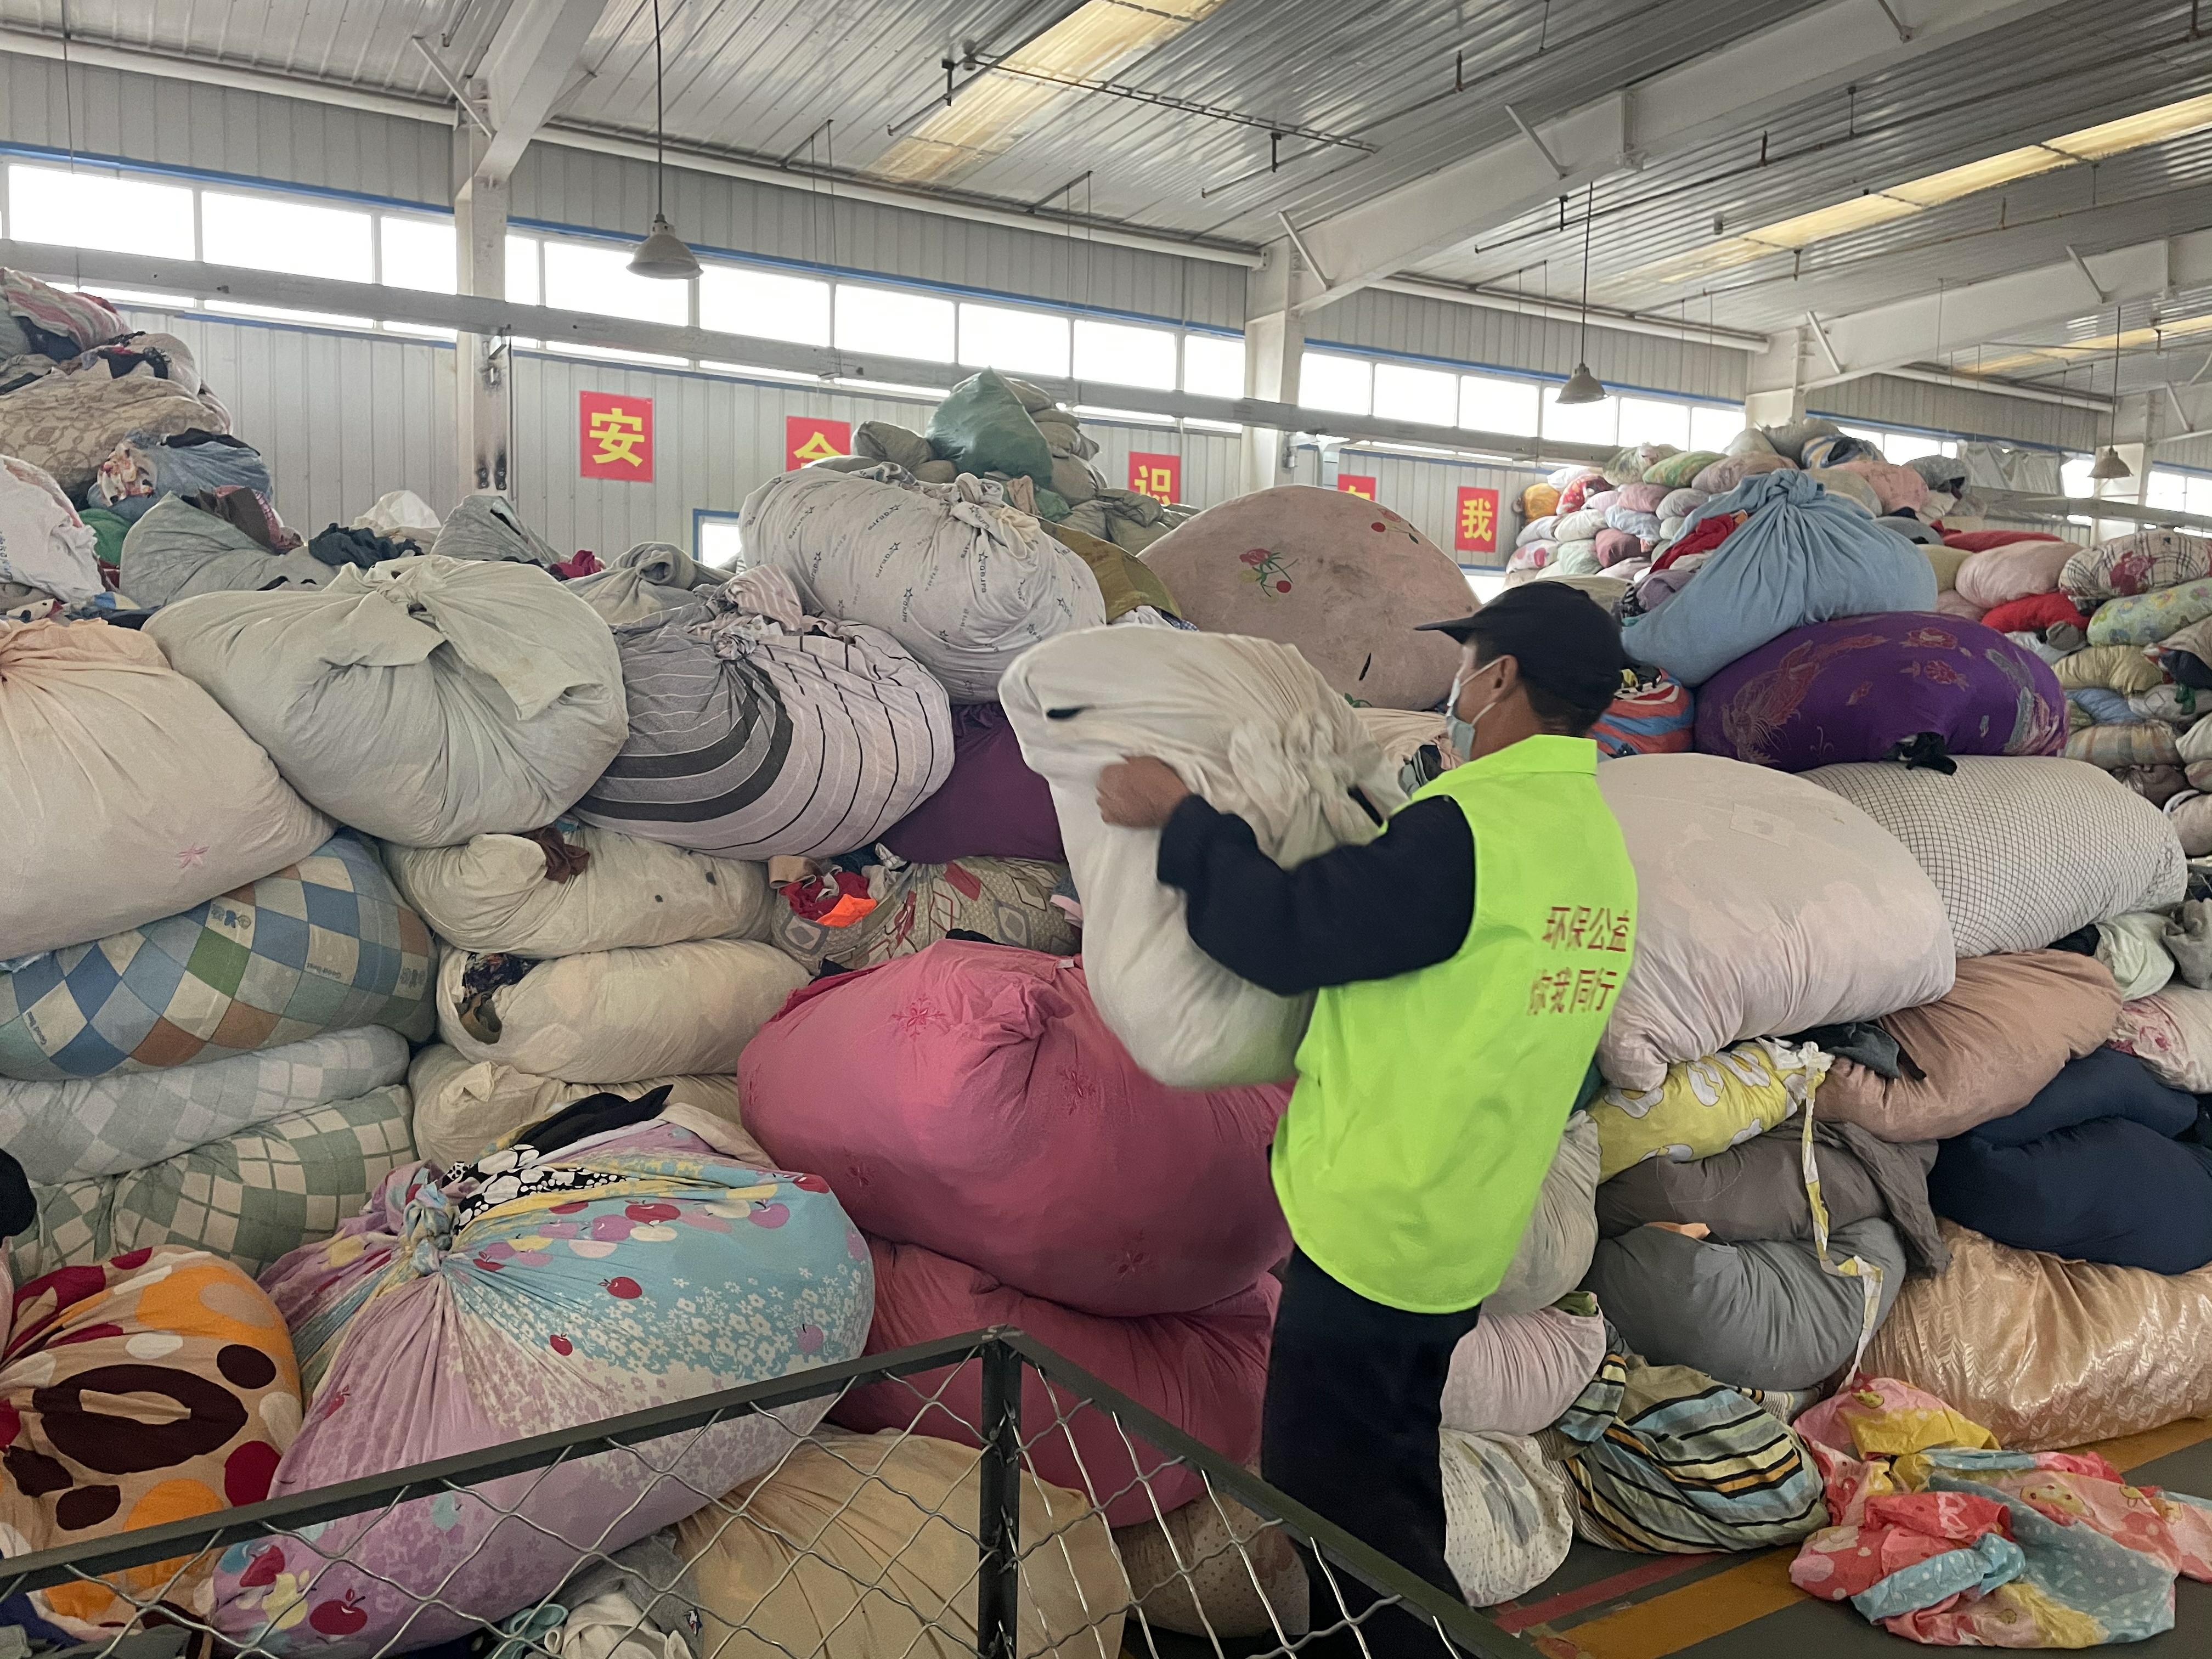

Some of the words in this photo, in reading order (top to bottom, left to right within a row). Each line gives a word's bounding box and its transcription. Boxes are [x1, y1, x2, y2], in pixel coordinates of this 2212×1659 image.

[589, 408, 645, 467] 安
[1133, 465, 1171, 506] 识
[1462, 498, 1493, 542] 我
